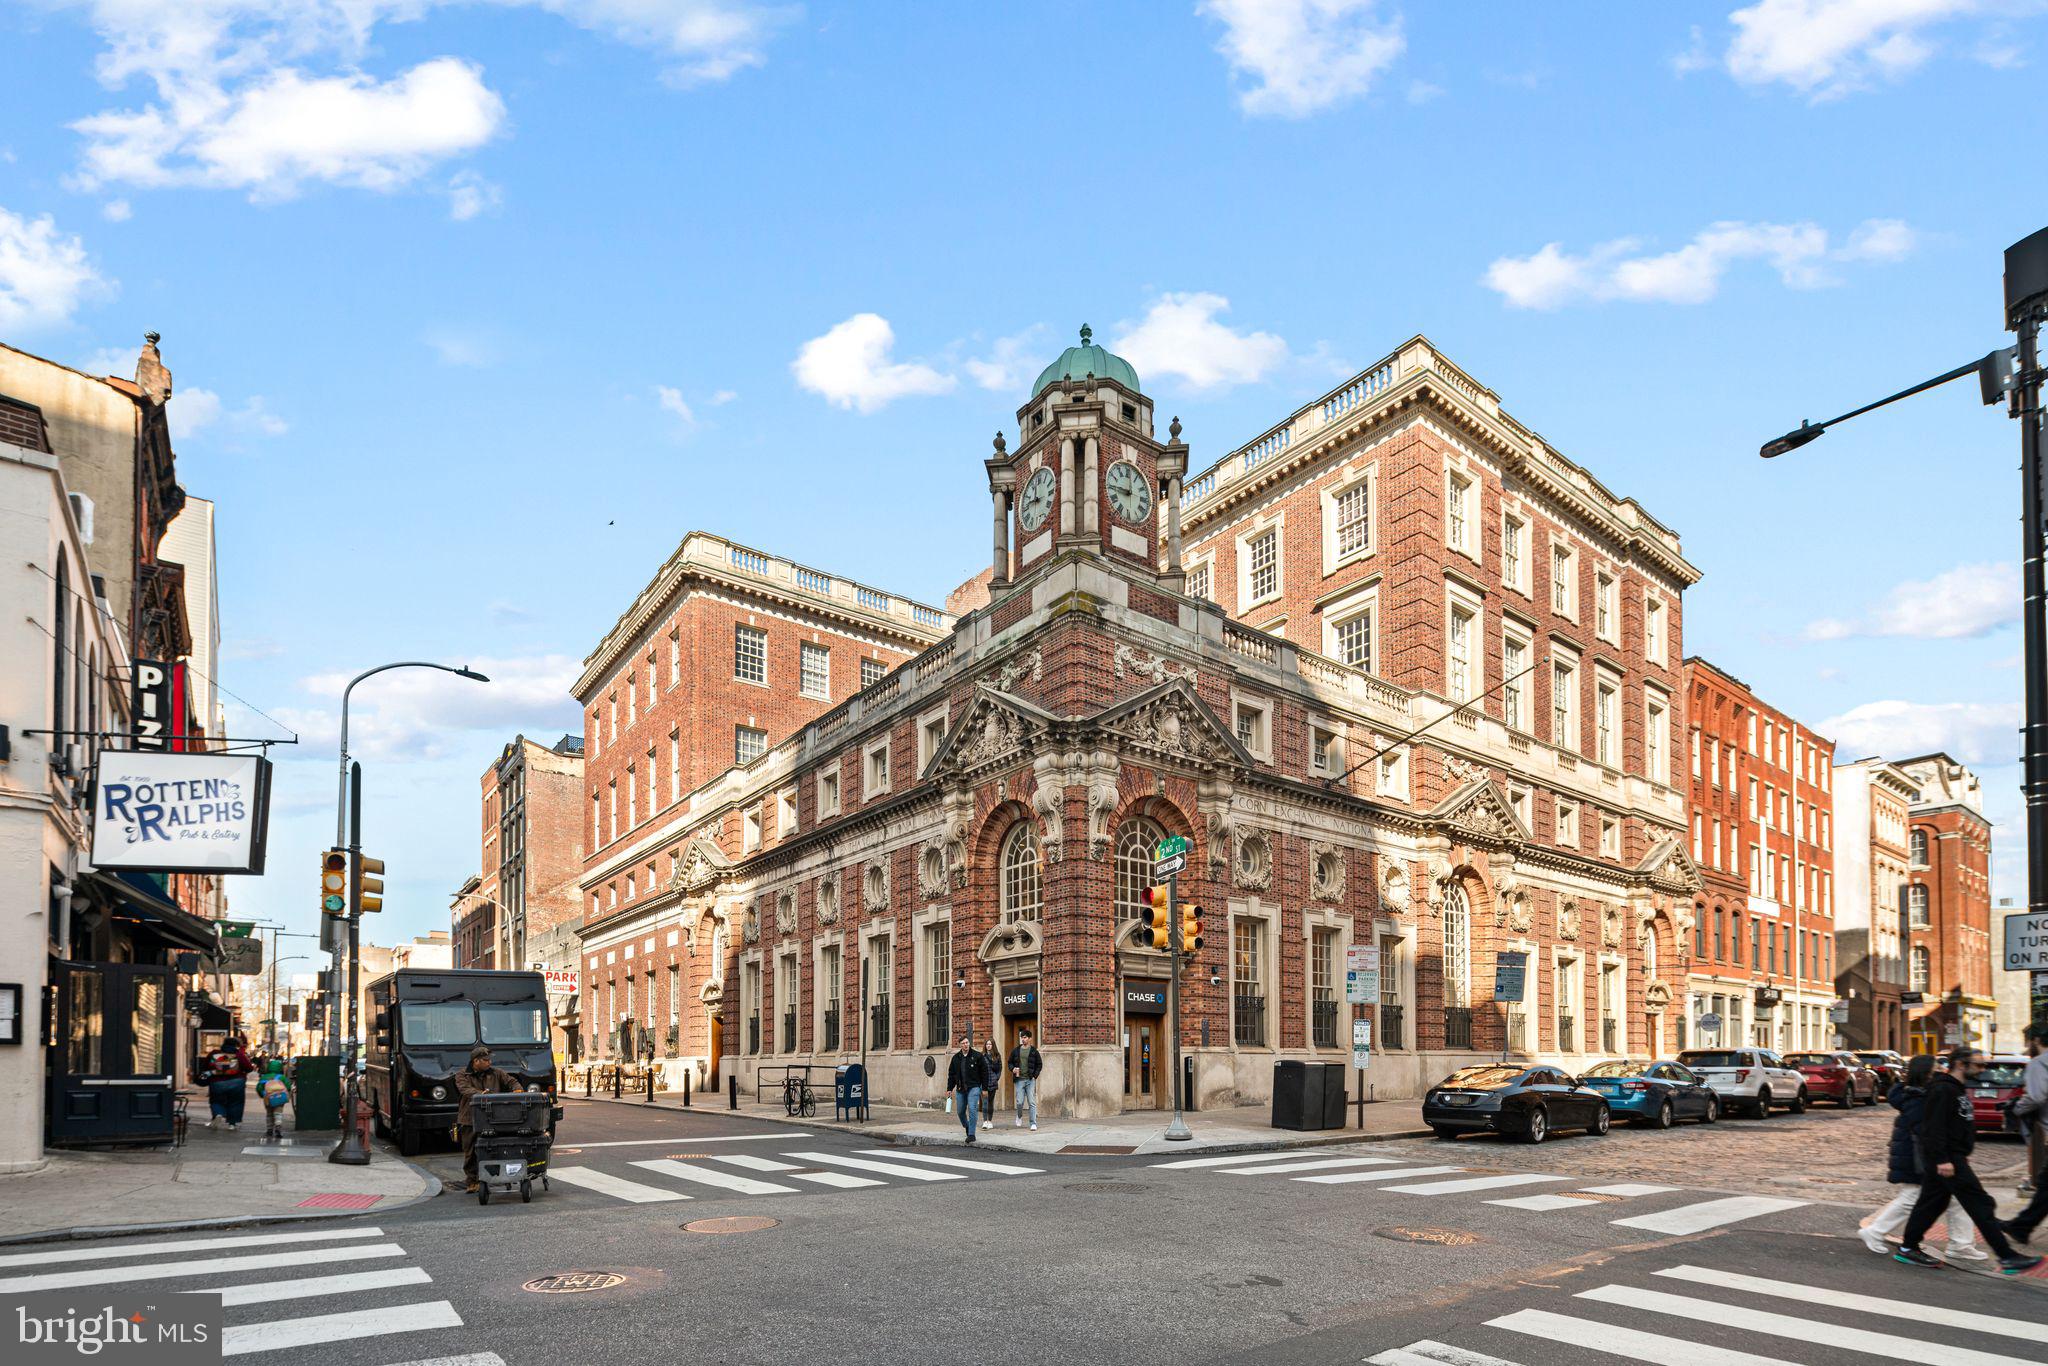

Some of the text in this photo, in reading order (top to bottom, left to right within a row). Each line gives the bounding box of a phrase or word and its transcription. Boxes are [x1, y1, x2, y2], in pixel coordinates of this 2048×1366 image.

[138, 665, 163, 751] PIZ
[102, 778, 219, 823] ROTTEN
[1239, 796, 1267, 813] CORN
[1274, 804, 1328, 826] EXCHANGE
[134, 801, 246, 842] RALPHS
[179, 829, 241, 841] Pub & Eatery
[1161, 845, 1173, 858] 2ND
[2027, 919, 2048, 931] NO
[2018, 936, 2048, 948] TUR
[2009, 953, 2031, 964] ON
[546, 972, 577, 982] PARK
[1004, 994, 1026, 1004] CHASE
[1127, 992, 1156, 1002] CHASE
